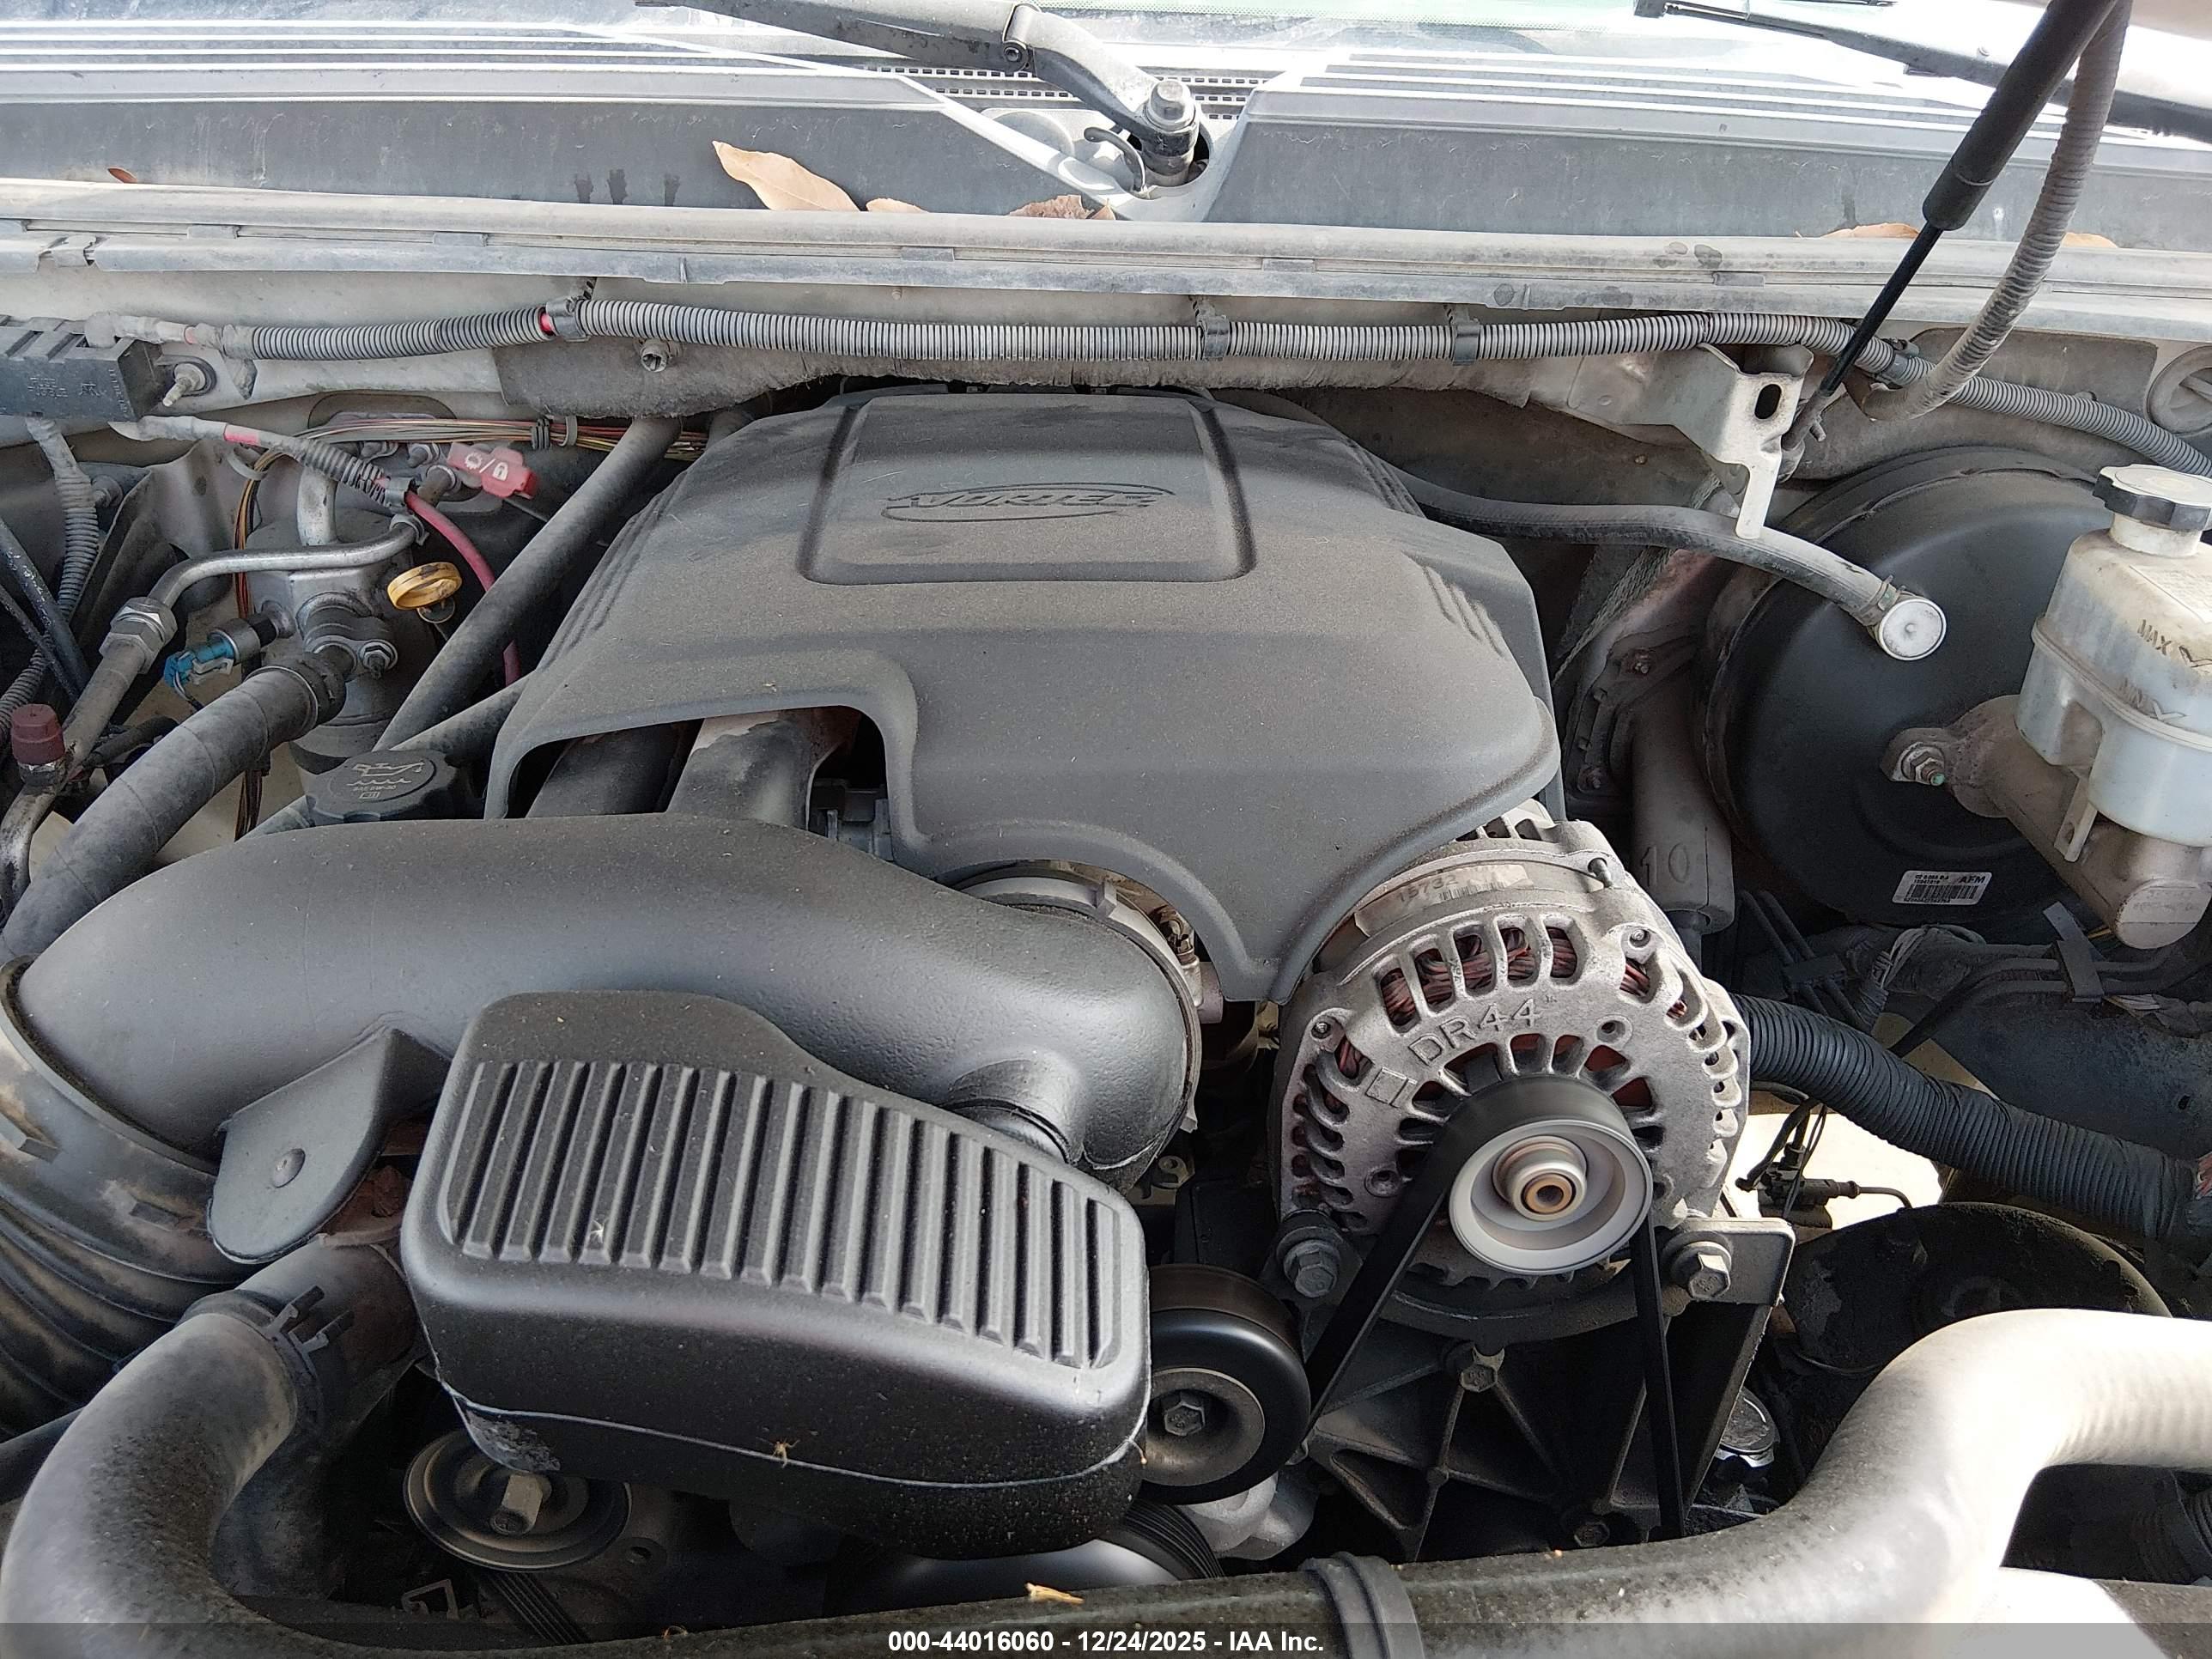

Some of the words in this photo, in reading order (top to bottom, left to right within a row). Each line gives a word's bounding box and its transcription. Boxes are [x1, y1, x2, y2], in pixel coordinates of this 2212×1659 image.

[2136, 619, 2172, 656] MAX
[1640, 842, 1691, 887] 10
[1959, 875, 1986, 884] AFM
[1407, 997, 1543, 1066] DR44
